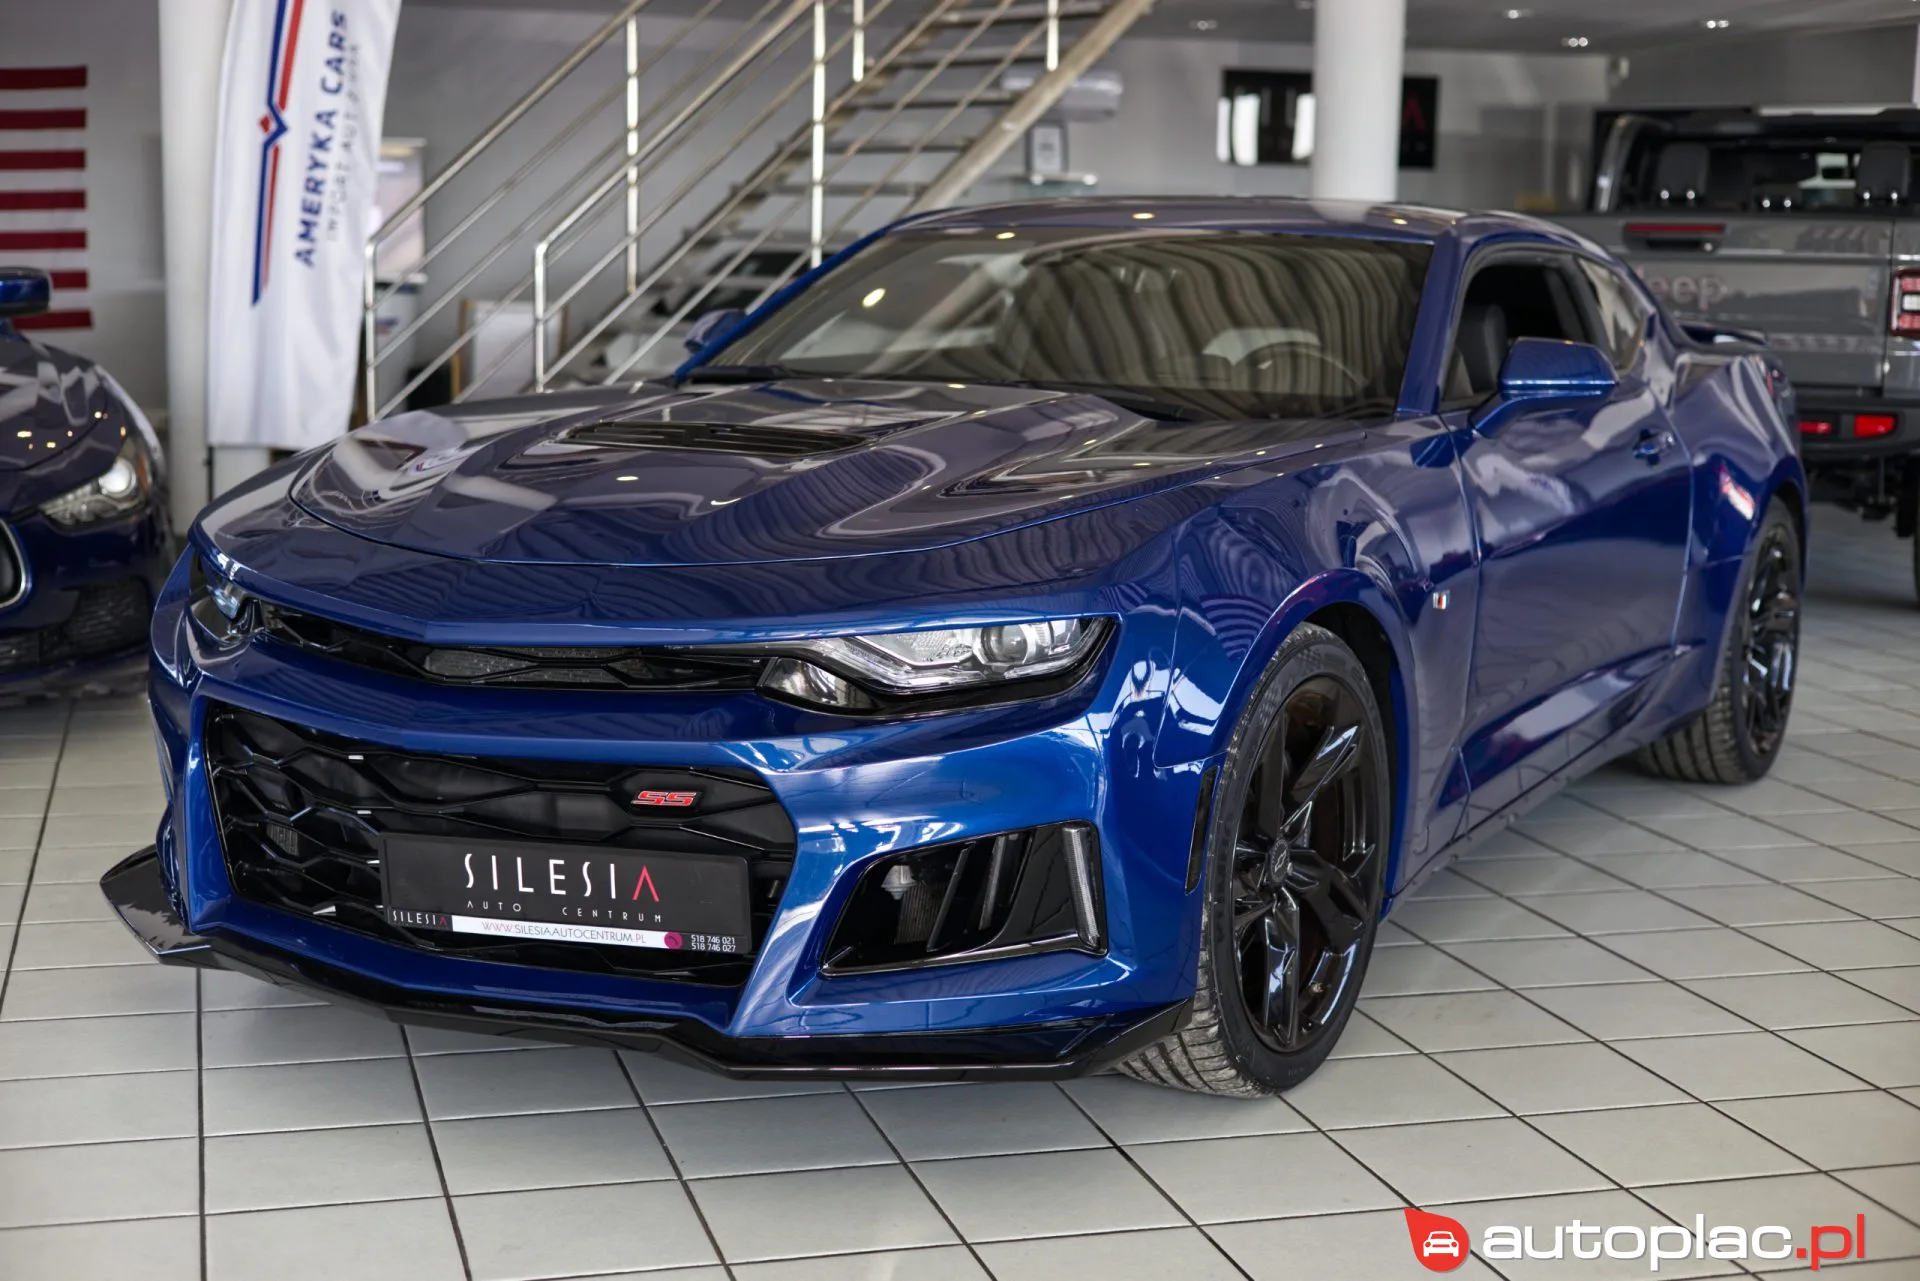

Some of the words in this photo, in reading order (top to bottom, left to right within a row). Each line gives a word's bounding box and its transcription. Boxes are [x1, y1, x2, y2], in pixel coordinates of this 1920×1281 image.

[295, 108, 338, 269] AMERYKA
[320, 9, 347, 96] CARS
[630, 790, 697, 807] SS
[464, 853, 660, 902] SILESIA
[393, 910, 447, 926] SILESIA
[467, 900, 522, 912] AUTO
[562, 906, 661, 923] CENTRUM
[481, 921, 647, 943] WWW.SILESIAAUTOCENTRUM.PL
[691, 935, 705, 943] 518
[706, 936, 721, 944] 746
[691, 943, 705, 951] 518
[707, 944, 721, 952] 746
[722, 944, 736, 952] 027
